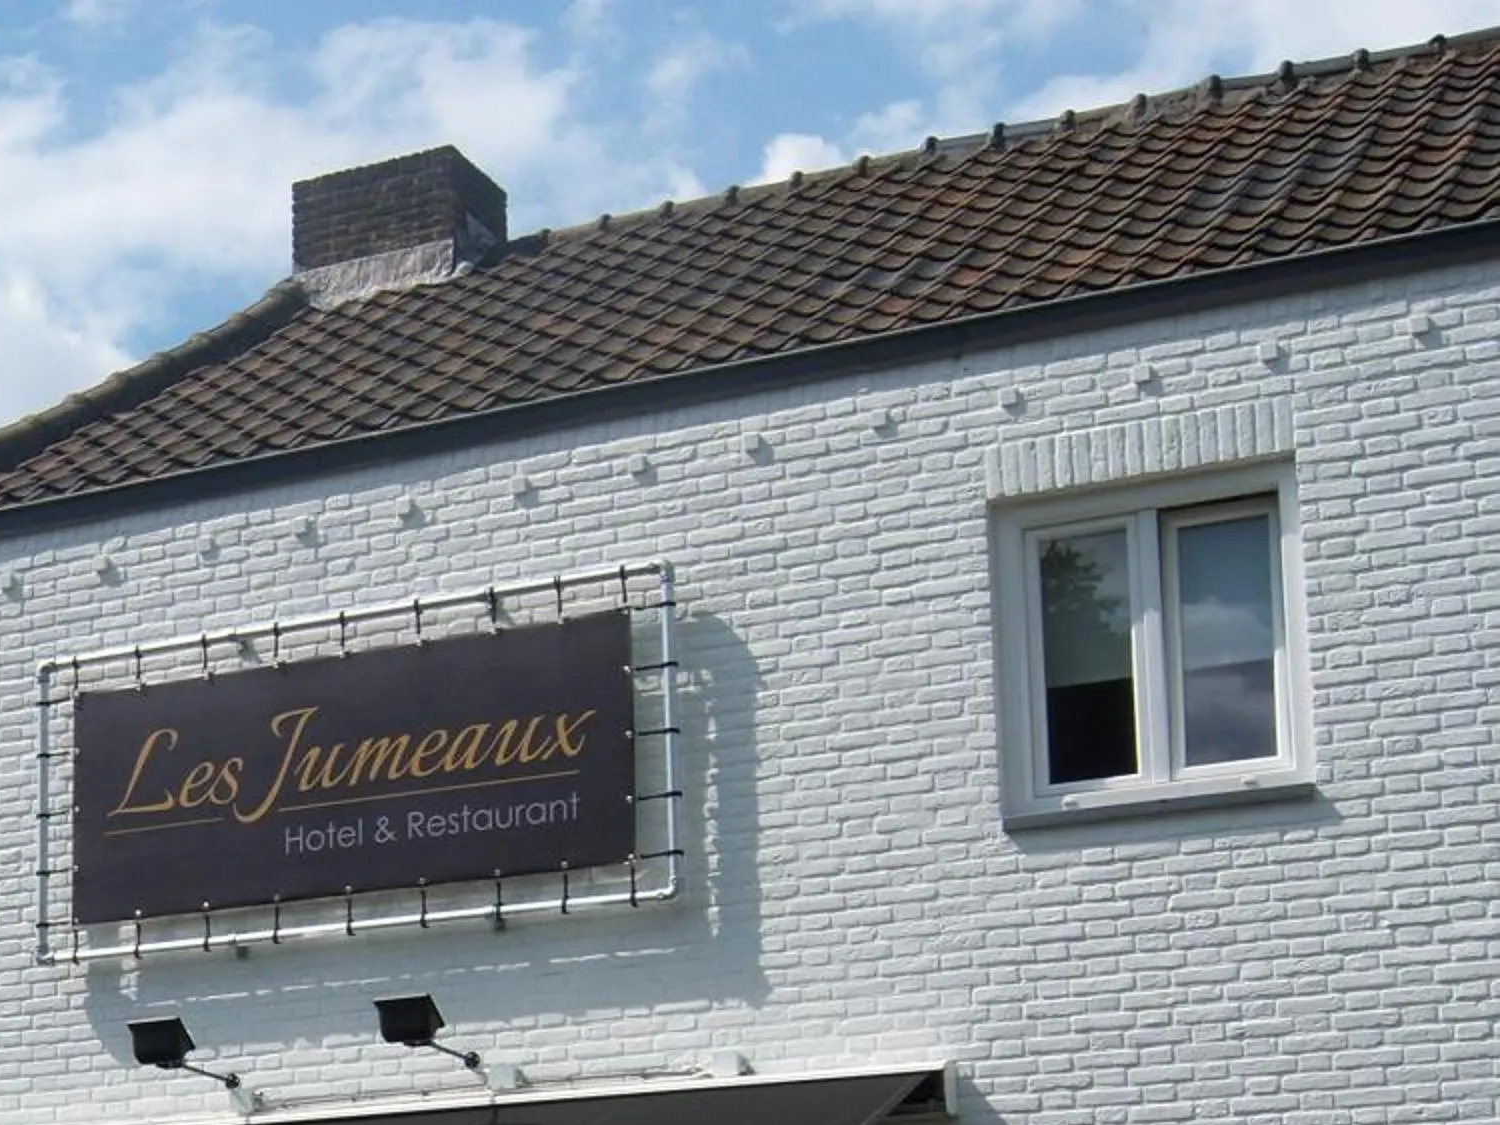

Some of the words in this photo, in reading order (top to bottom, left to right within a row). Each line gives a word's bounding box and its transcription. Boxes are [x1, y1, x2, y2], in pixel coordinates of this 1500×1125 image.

[107, 727, 244, 817] Les
[234, 707, 596, 824] Jumeaux
[285, 818, 363, 855] Hotel
[375, 815, 397, 844] &
[408, 792, 581, 839] Restaurant
